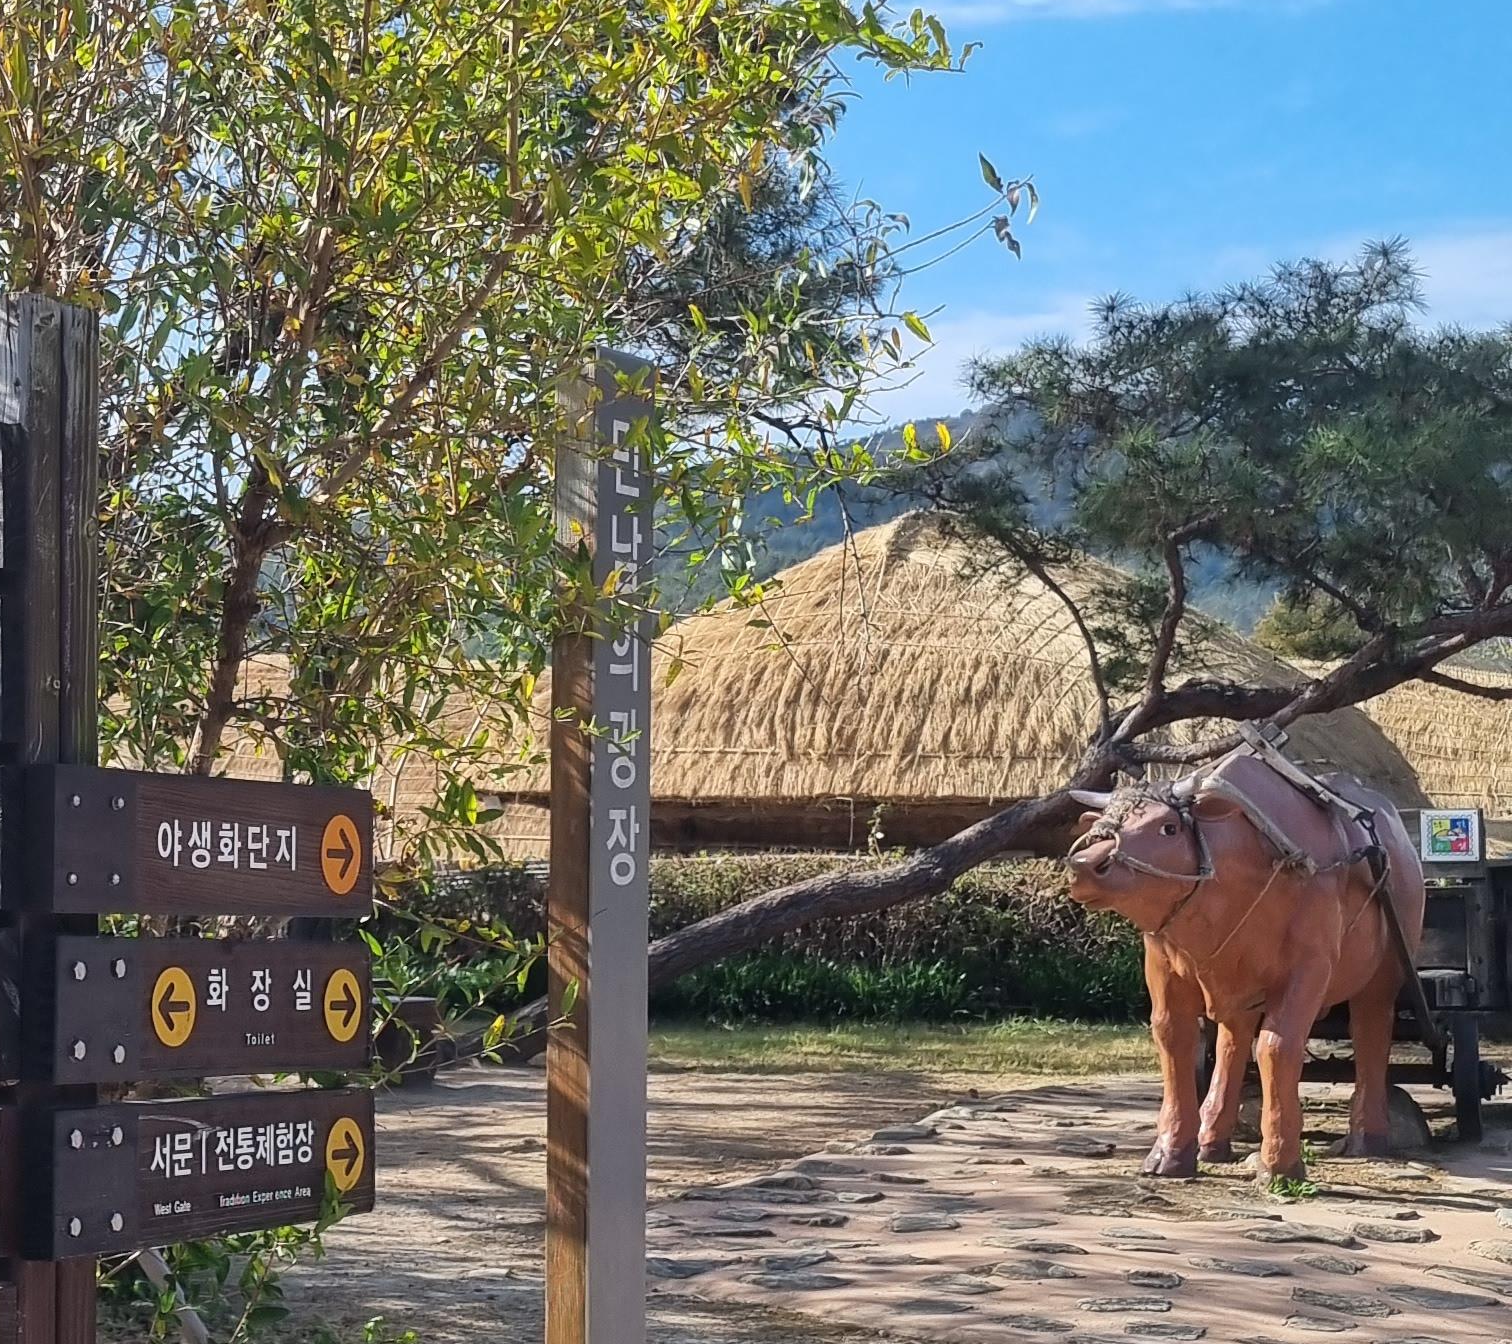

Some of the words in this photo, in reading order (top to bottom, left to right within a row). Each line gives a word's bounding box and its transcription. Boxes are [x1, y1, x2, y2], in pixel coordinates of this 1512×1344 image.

[157, 819, 298, 872] 야생화단지
[206, 967, 313, 1012] 화장실
[245, 1032, 276, 1046] Toilet
[150, 1133, 194, 1179] 서문
[215, 1120, 315, 1172] 전통체험장
[153, 1201, 172, 1216] West
[173, 1199, 192, 1214] Gate
[252, 1189, 291, 1205] Experence
[294, 1185, 312, 1199] Area
